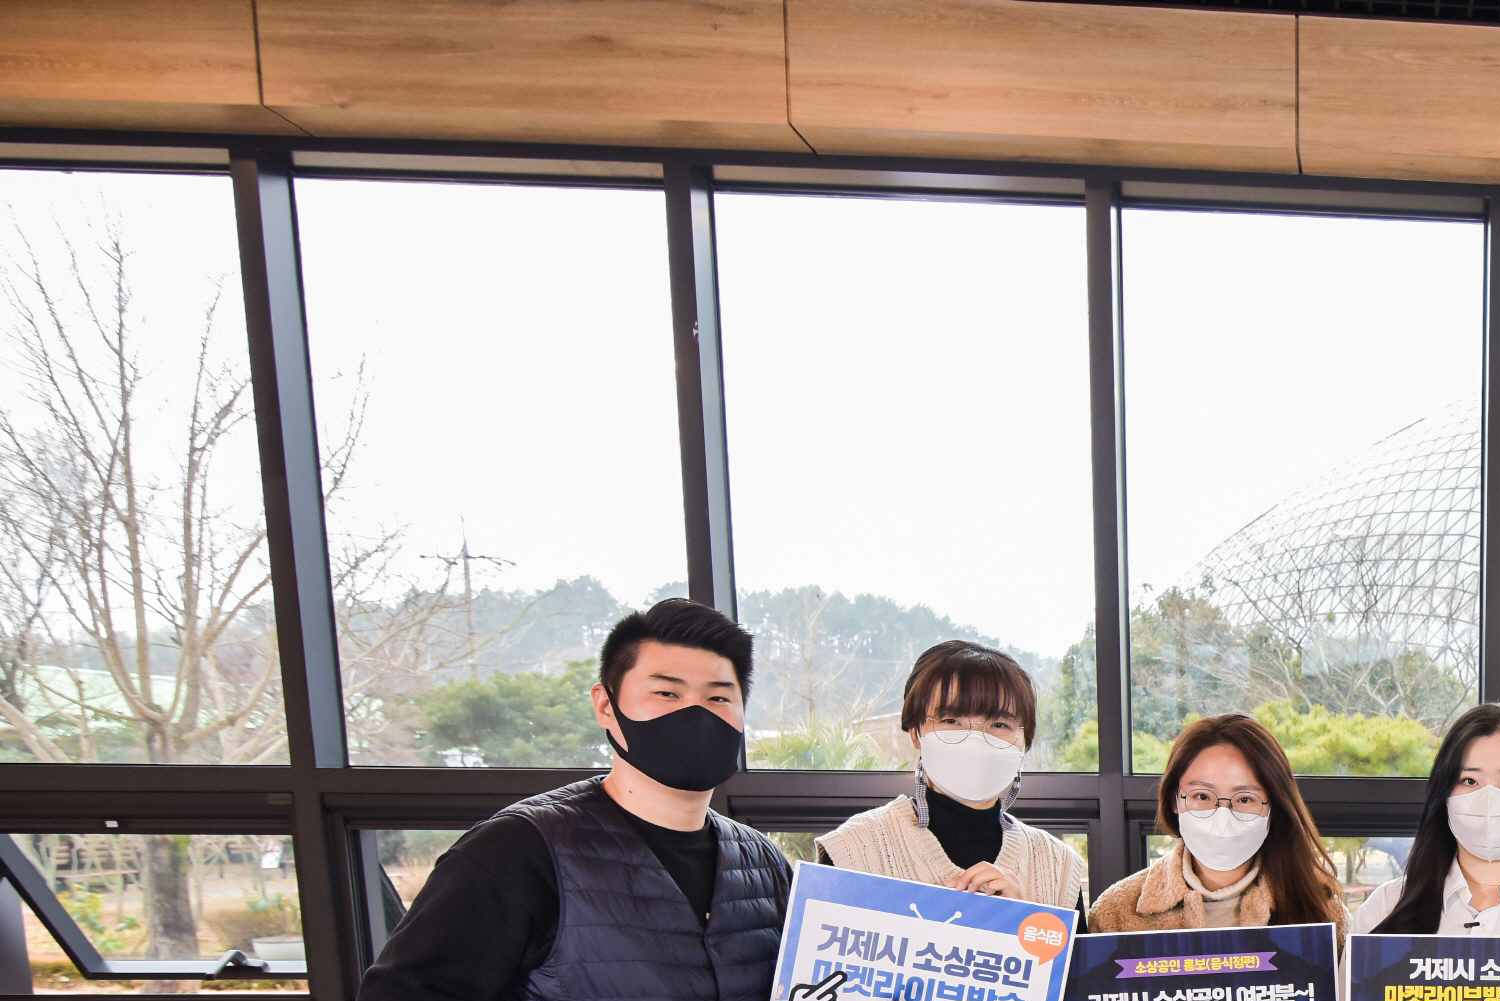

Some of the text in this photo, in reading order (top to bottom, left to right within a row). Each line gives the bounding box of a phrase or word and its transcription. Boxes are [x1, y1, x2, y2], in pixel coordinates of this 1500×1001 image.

[1023, 926, 1063, 946] 음식점
[817, 923, 1032, 989] 거제시 소상공인
[1135, 955, 1260, 974] 소상공인 홍보(음식점편)
[1410, 957, 1475, 981] 거제시
